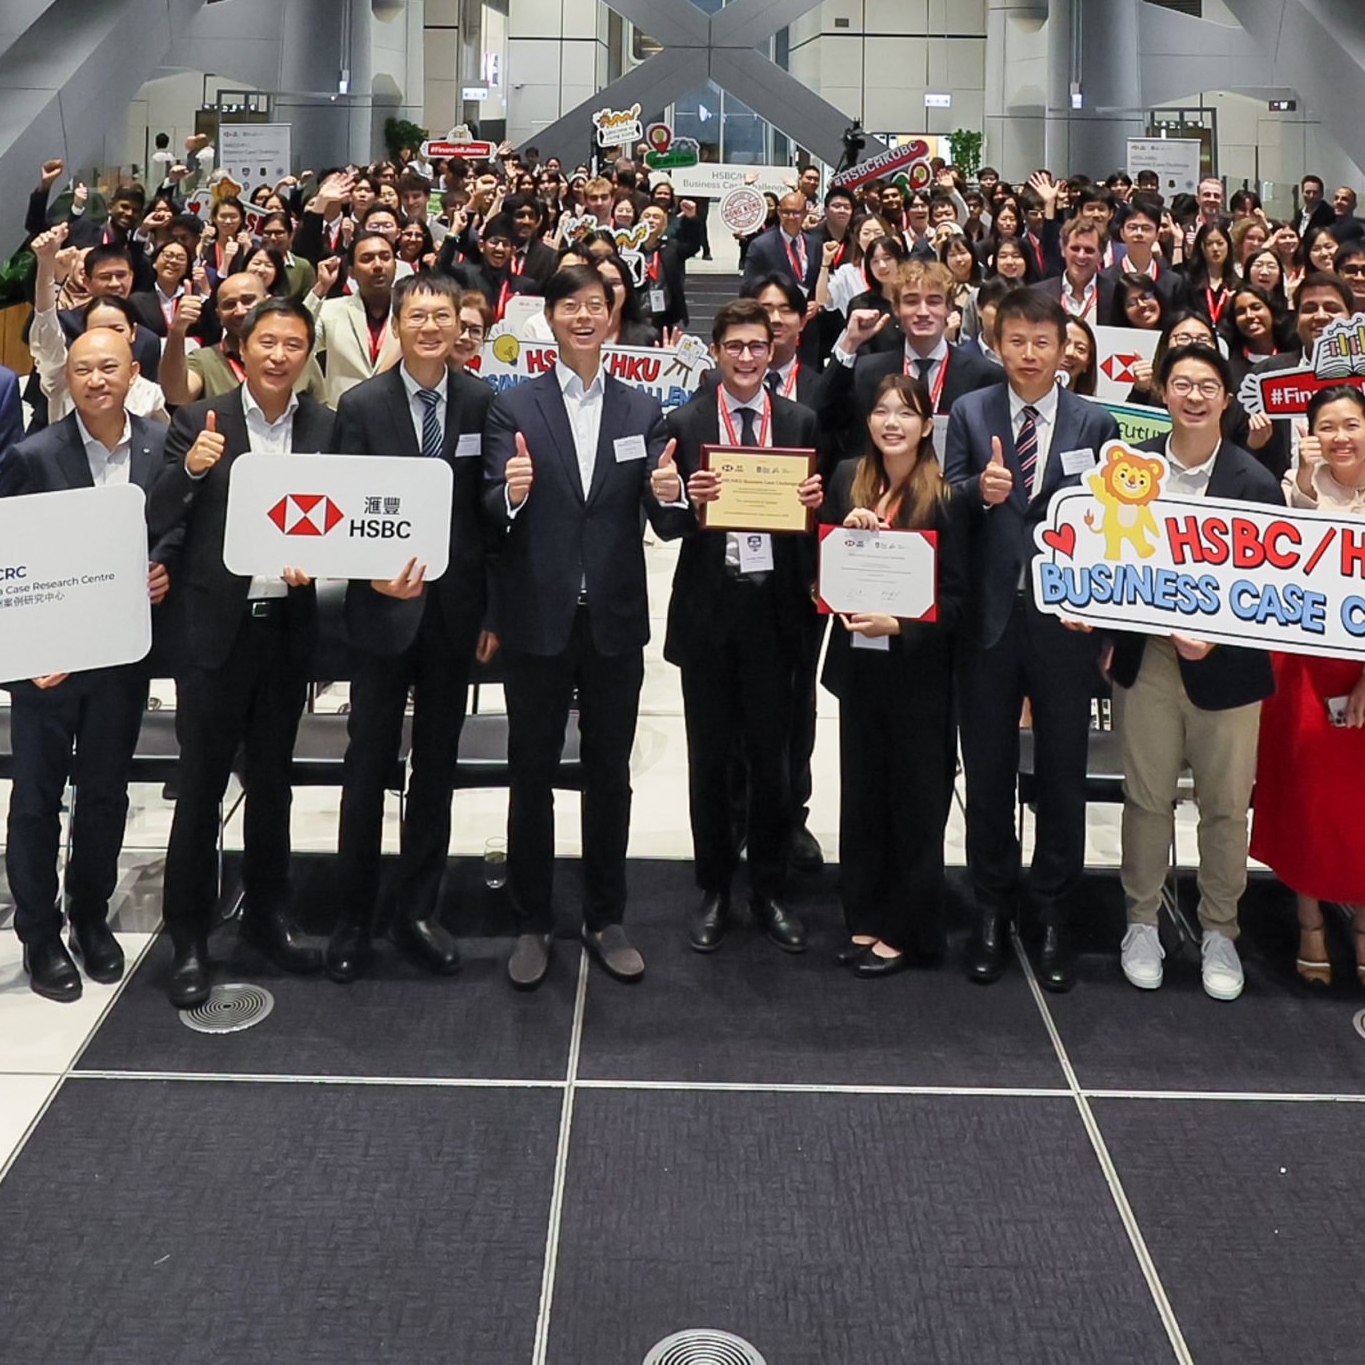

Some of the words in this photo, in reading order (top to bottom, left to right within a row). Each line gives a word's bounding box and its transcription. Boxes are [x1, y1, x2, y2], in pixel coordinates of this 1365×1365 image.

[834, 141, 919, 187] #HSBCHKUBC
[683, 179, 720, 188] Business
[349, 519, 412, 539] HSBC
[5, 584, 31, 595] Case
[32, 577, 79, 591] Research
[81, 572, 115, 585] Centre
[1039, 562, 1221, 615] BUSINESS
[1229, 578, 1327, 633] CASE
